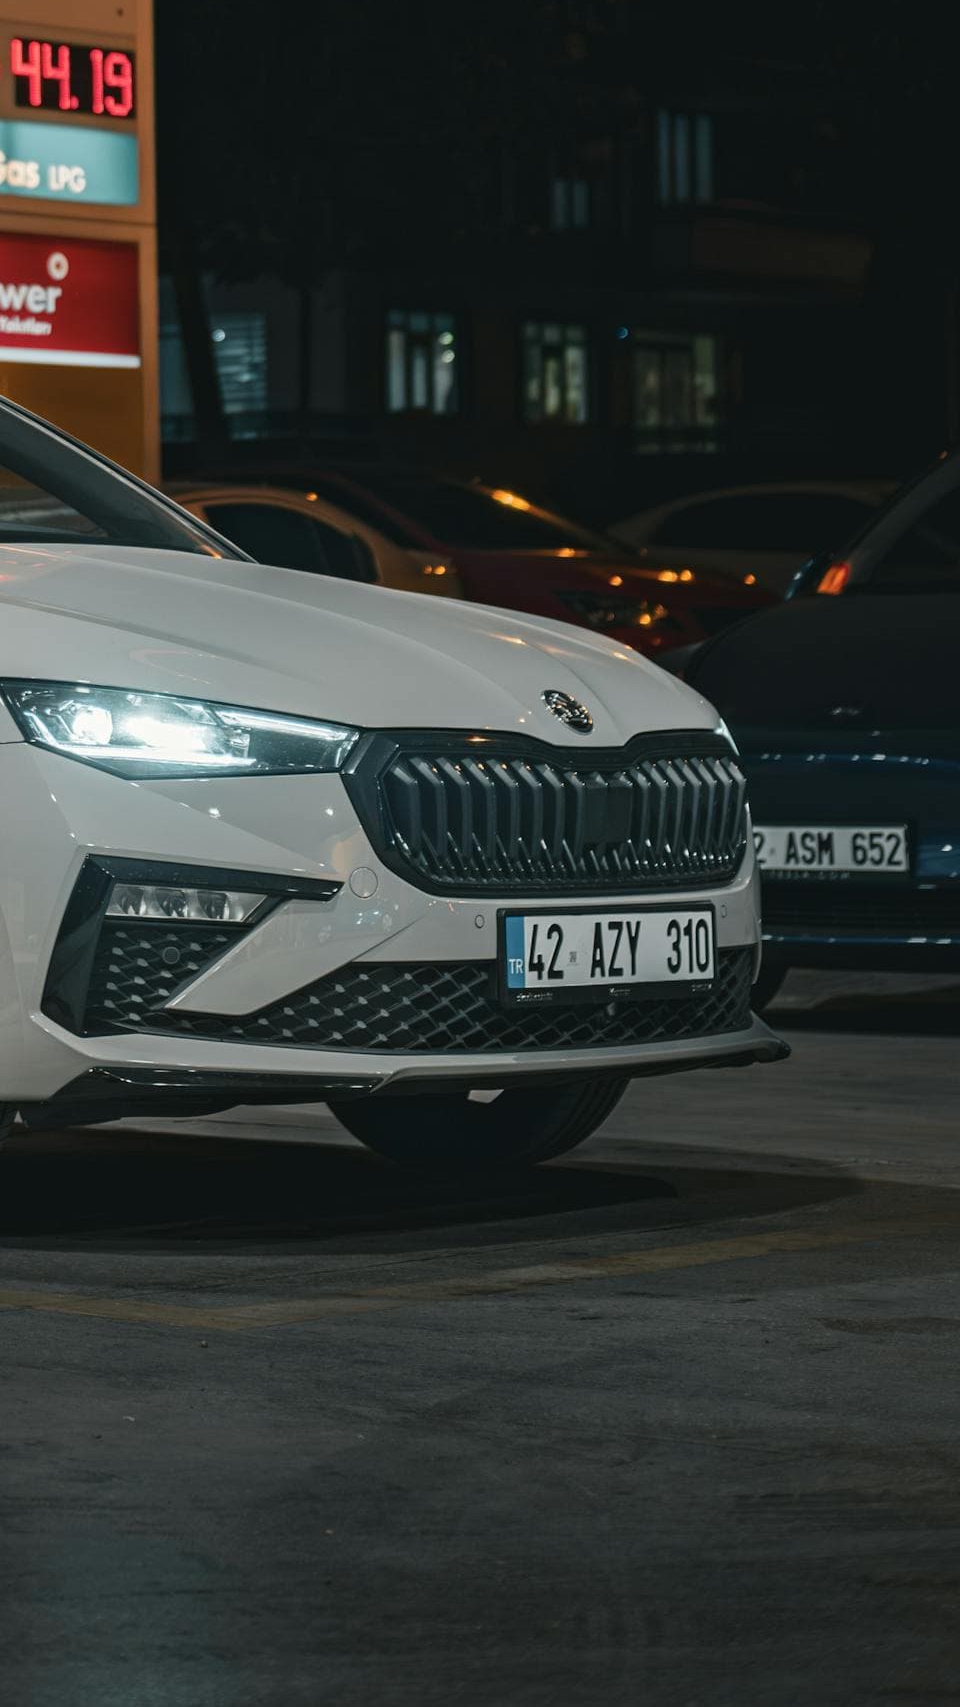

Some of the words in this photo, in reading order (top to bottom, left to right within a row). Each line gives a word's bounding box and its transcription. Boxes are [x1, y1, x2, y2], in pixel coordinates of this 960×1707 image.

[47, 164, 87, 193] LPG
[785, 831, 836, 866] ASM
[852, 833, 903, 866] 652
[528, 923, 564, 980] 42
[590, 920, 641, 978] AZY
[667, 918, 710, 974] 310
[508, 959, 524, 974] TR
